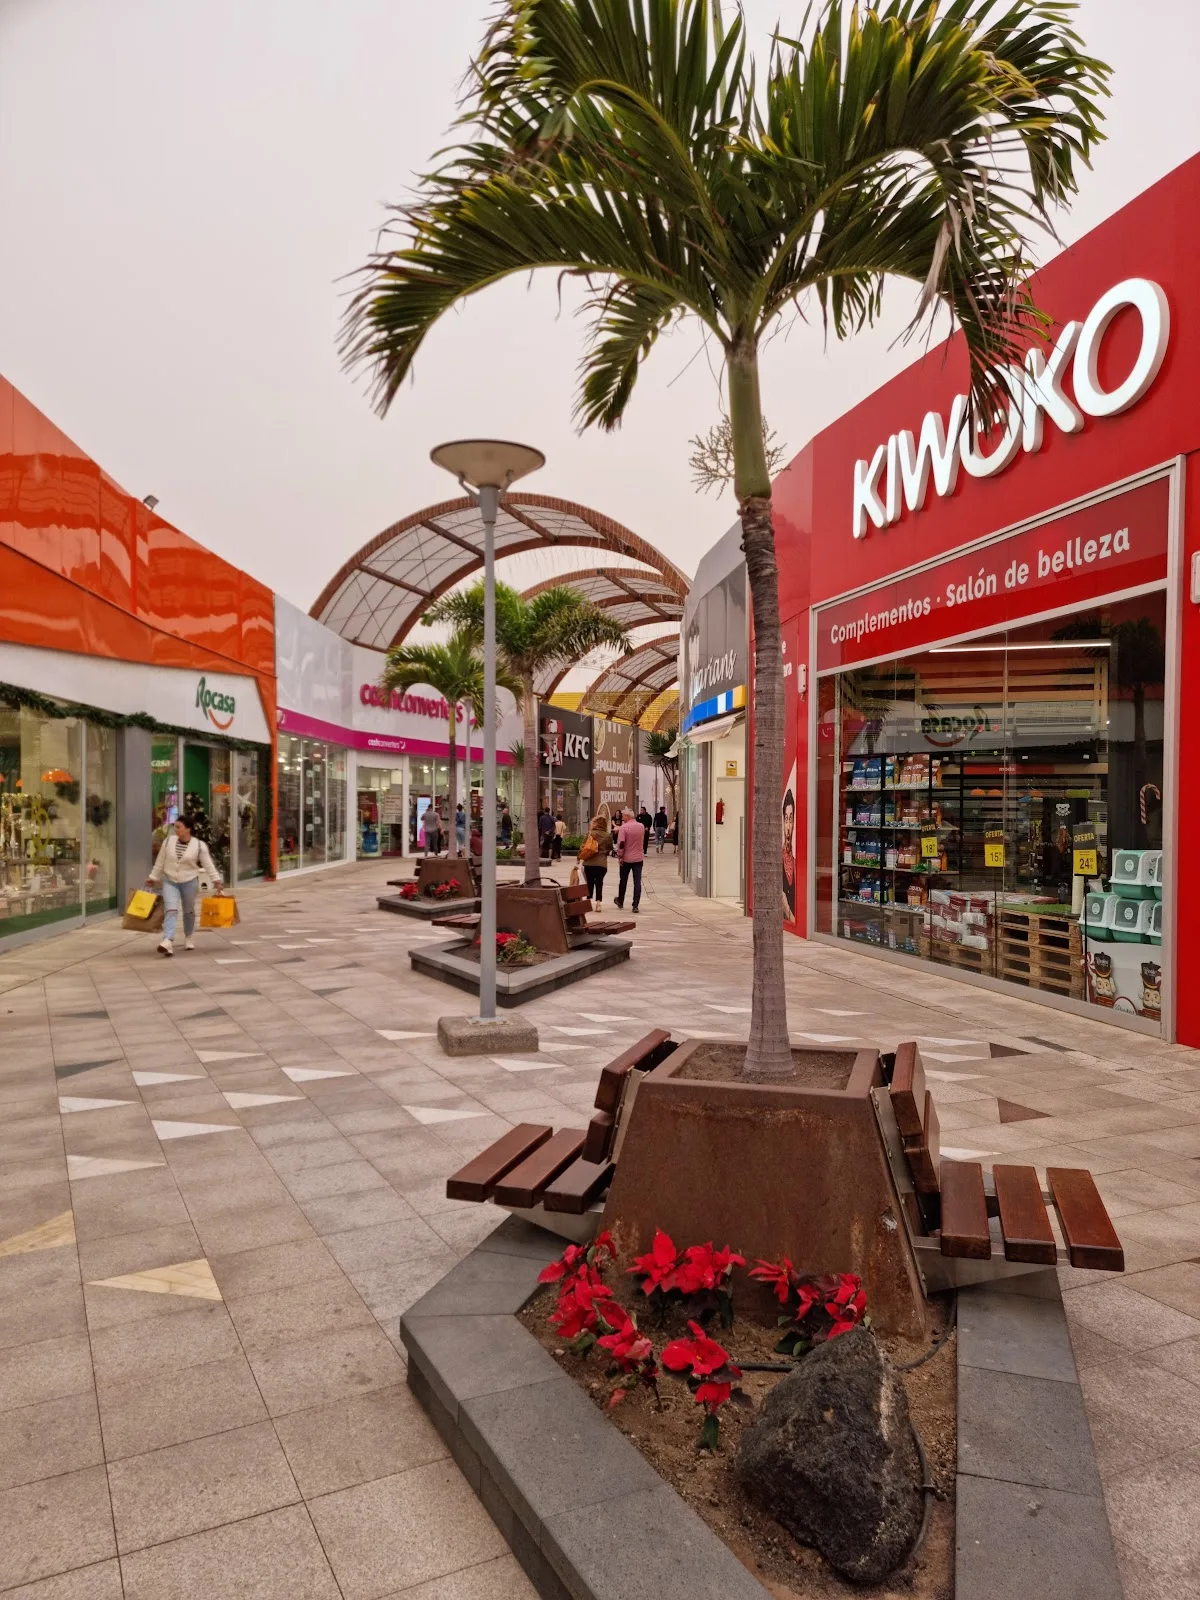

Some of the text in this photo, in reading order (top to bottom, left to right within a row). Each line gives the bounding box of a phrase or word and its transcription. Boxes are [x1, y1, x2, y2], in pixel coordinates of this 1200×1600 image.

[852, 277, 1170, 539] KIWOKO
[830, 527, 1130, 645] Complementos Salón de belleza
[196, 676, 235, 720] Rocasa
[564, 733, 590, 760] KFC
[986, 830, 1003, 838] OFERTA
[1074, 832, 1094, 842] OFERTA
[990, 852, 998, 862] 15
[1080, 858, 1089, 869] 24
